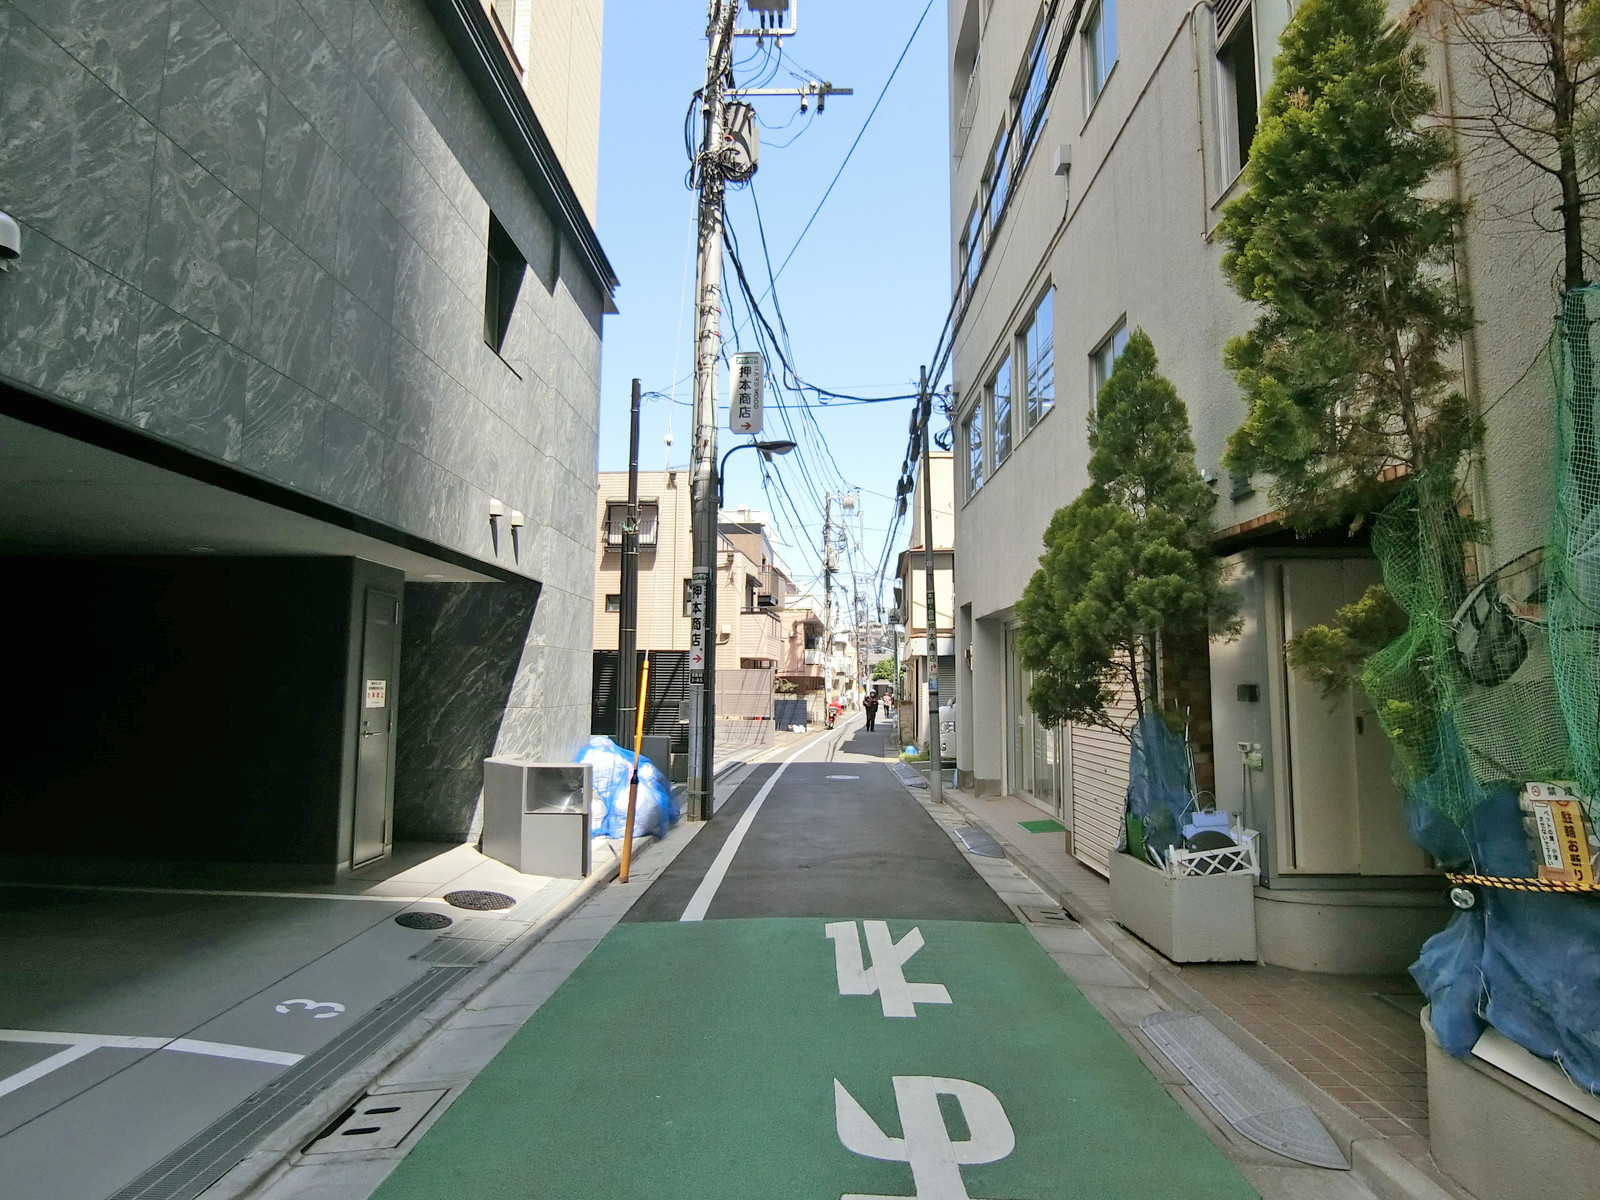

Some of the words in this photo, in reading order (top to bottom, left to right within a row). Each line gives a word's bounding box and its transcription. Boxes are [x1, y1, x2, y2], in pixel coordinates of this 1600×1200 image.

[739, 366, 751, 418] 押本商店
[692, 585, 702, 647] 押本商店
[1561, 810, 1584, 882] 駐輪お断り
